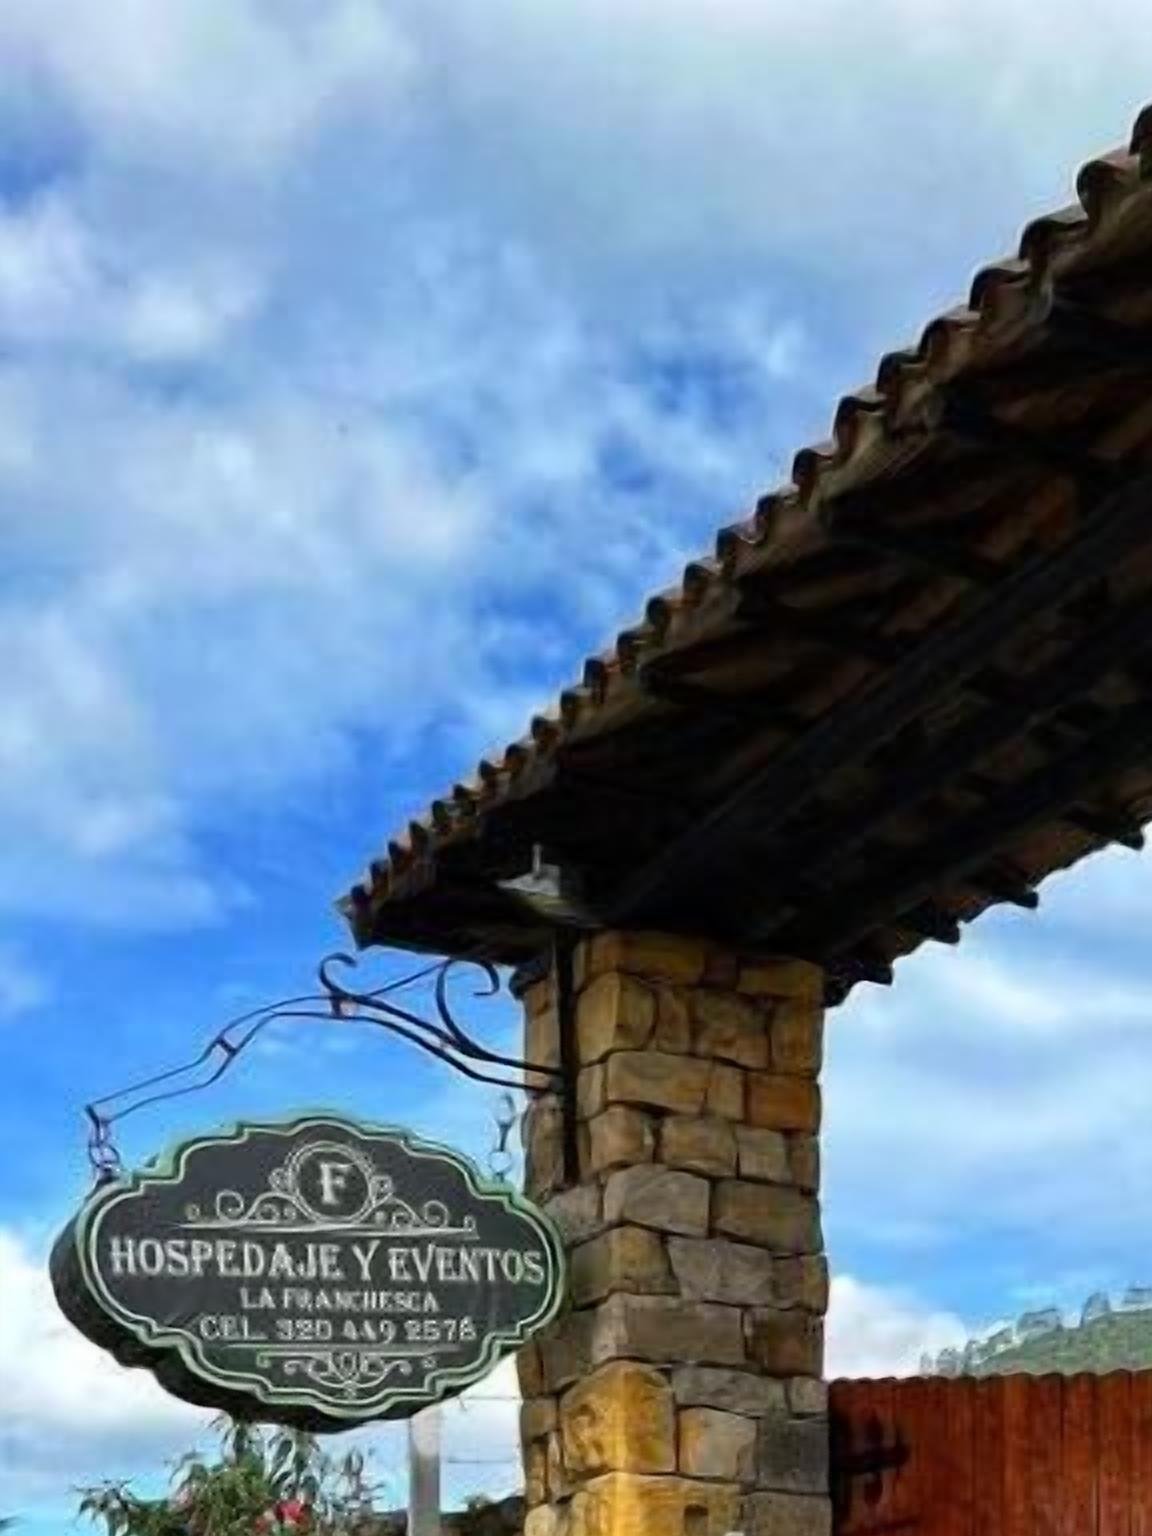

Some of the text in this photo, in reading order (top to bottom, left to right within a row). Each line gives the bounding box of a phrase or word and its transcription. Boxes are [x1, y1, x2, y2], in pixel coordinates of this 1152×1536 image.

[319, 1162, 353, 1205] F
[111, 1237, 545, 1286] HOSPEDAJE Y EVENTOS
[240, 1287, 439, 1312] LA FRANCHESCA
